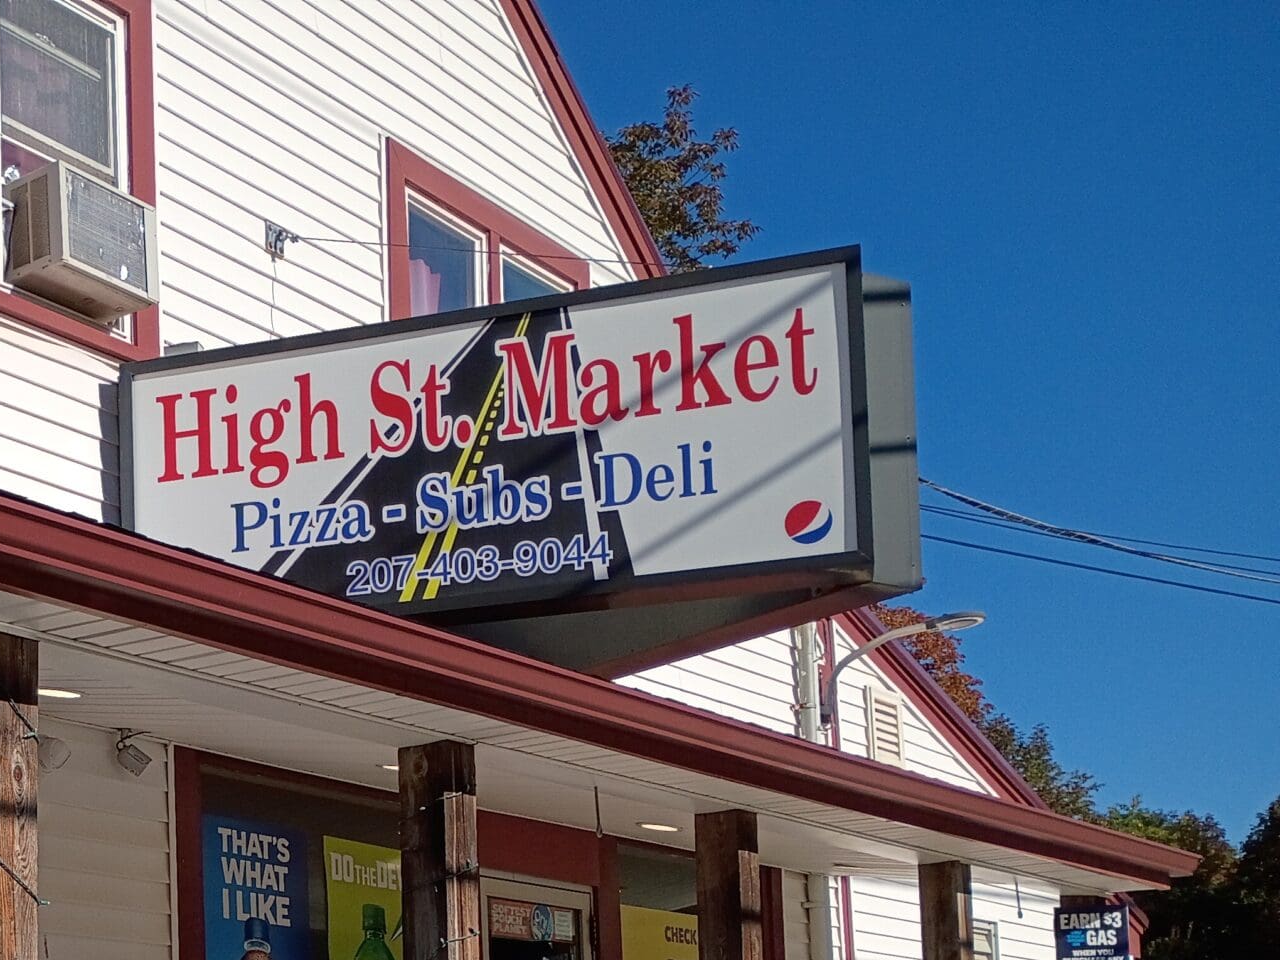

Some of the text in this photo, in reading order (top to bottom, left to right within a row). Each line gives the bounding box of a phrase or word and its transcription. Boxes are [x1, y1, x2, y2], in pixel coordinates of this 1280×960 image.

[155, 307, 818, 489] High St. Market
[230, 497, 372, 553] Pizza
[418, 467, 548, 530] Subs
[599, 440, 718, 508] Deli
[346, 532, 612, 595] 207-403-9044
[218, 827, 290, 863] THAT'S
[221, 857, 288, 892] WHAT
[330, 852, 354, 883] DO
[355, 864, 377, 887] THE
[223, 888, 291, 927] I LIKE
[1060, 911, 1122, 929] EARN $3
[665, 926, 697, 945] CHECK
[1086, 930, 1117, 946] GAS
